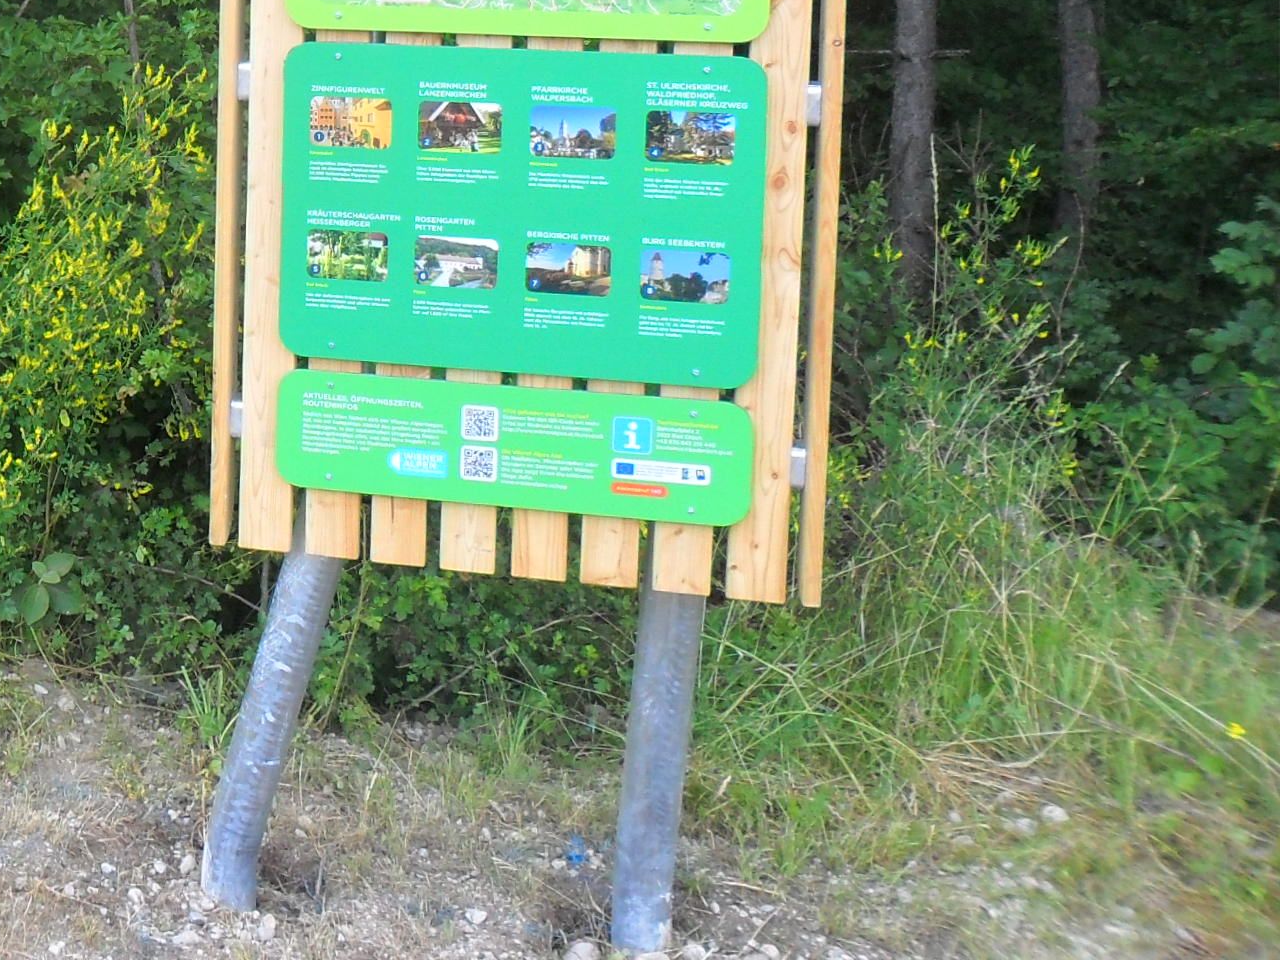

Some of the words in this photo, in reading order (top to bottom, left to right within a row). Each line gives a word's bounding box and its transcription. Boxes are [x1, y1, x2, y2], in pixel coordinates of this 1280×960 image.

[419, 81, 488, 90] BAUERNMUSEUM
[418, 89, 487, 99] LANZENKIRCHEN
[414, 216, 475, 226] ROSENGARTEN
[414, 224, 443, 232] PITTEN
